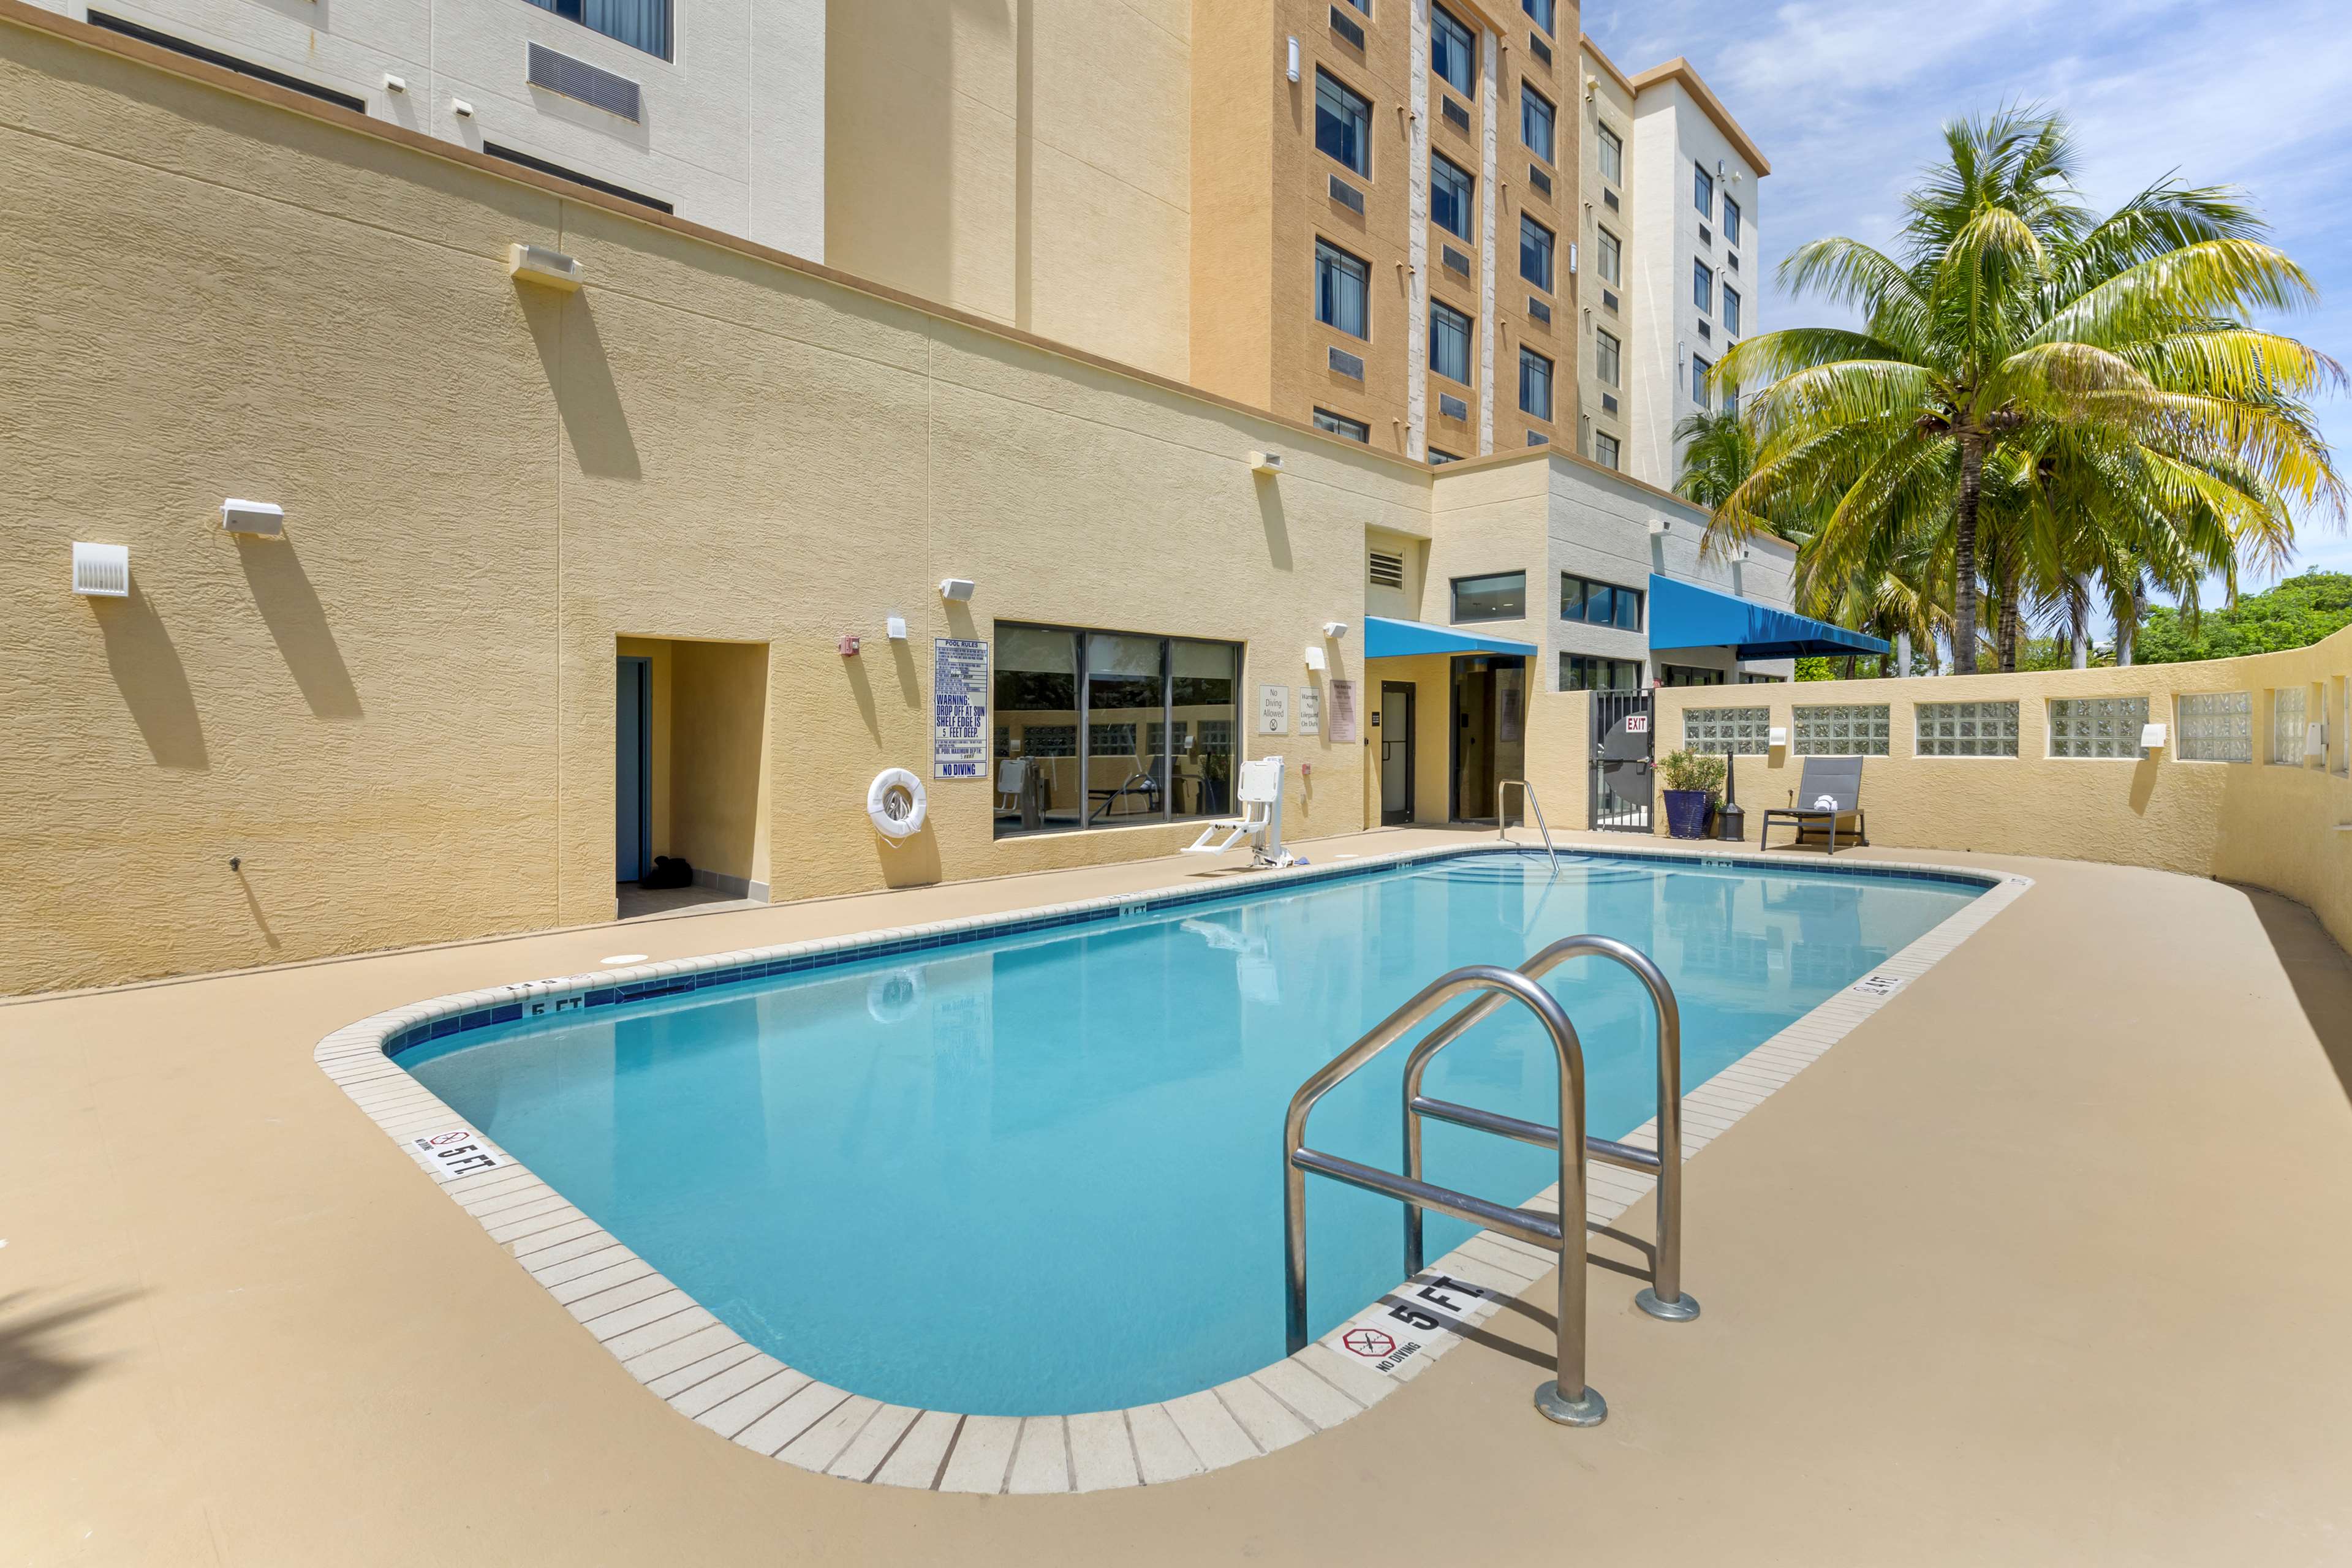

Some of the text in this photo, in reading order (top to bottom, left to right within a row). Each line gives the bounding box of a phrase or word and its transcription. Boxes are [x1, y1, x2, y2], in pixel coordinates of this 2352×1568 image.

[937, 694, 970, 706] WARNING:
[1301, 693, 1318, 701] Warning
[1265, 698, 1282, 709] Diving
[937, 705, 985, 717] DROP OFF AT SUN
[1263, 709, 1284, 718] Allowed
[936, 716, 981, 728] SHELF EDGE IS
[1628, 718, 1646, 730] EXIT
[942, 727, 978, 737] 5 FEET DEEP.
[943, 764, 975, 775] NO DIVING
[556, 997, 582, 1011] FT
[437, 1144, 479, 1158] 5
[1388, 1305, 1440, 1330] 5
[1375, 1341, 1422, 1373] NO DIVING
